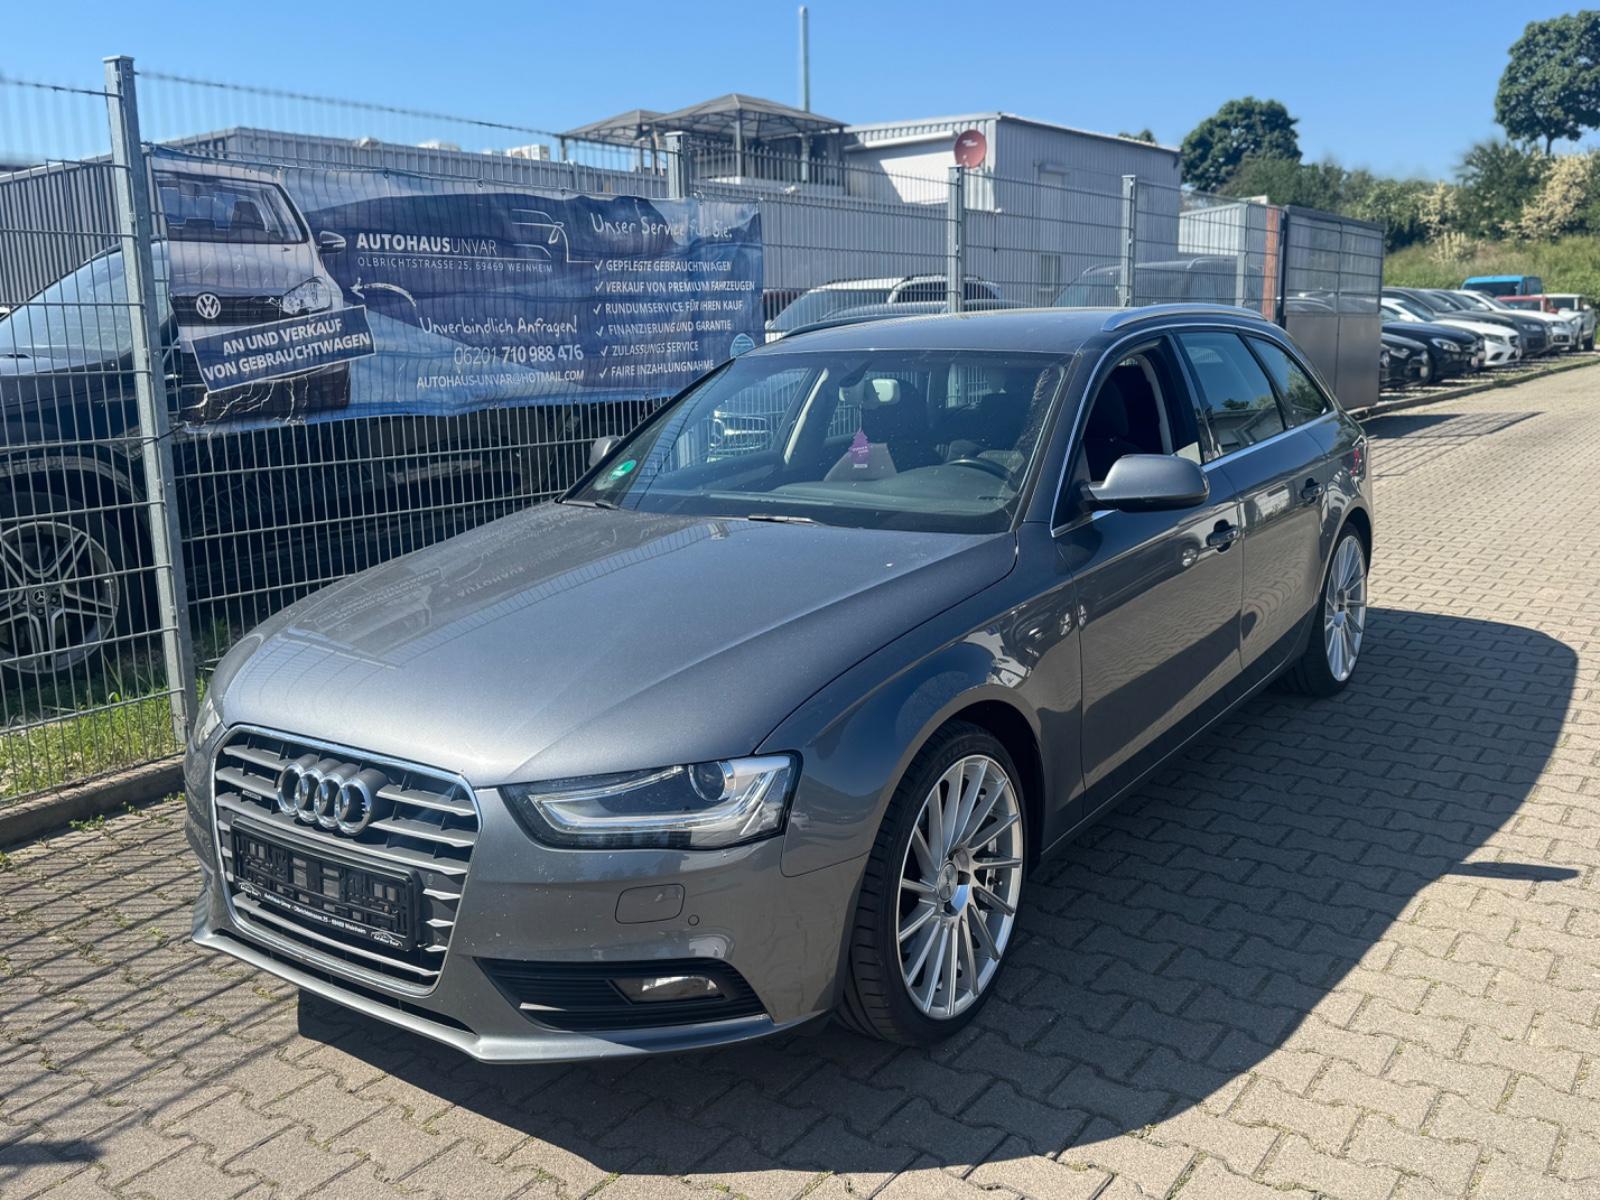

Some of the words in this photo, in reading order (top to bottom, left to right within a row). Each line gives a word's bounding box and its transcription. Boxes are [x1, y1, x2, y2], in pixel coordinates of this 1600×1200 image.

[590, 212, 637, 235] Unser
[641, 216, 685, 236] Service
[357, 257, 454, 270] OLBRICHTSTRASSE
[475, 262, 504, 272] 69469
[507, 262, 553, 273] WEINHEIM
[606, 260, 652, 272] GEPFLEGTE
[653, 260, 732, 272] GEBRAUCHTWAGEN
[606, 281, 645, 293] VERKAUF
[647, 281, 667, 293] VON
[668, 281, 709, 293] PREMIUM
[710, 280, 755, 292] FAHRZEUGEN
[605, 301, 684, 315] RUNDUMSERVICE
[723, 299, 744, 311] KAUF
[419, 317, 513, 335] Unverbindlich
[517, 314, 578, 338] Anfragen!
[608, 321, 676, 336] FINANZIERUNG
[695, 319, 732, 331] GARANTIE
[223, 338, 245, 356] AN
[246, 330, 279, 350] UND
[280, 318, 343, 343] VERKAUF
[203, 363, 238, 382] VON
[238, 332, 371, 373] GEBRAUCHTWAGEN
[454, 346, 497, 366] 06201
[501, 346, 526, 364] 710
[529, 345, 556, 363] 988
[557, 344, 584, 361] 476
[612, 343, 665, 357] ZULASSUNGS
[666, 340, 699, 354] SERVICE
[611, 364, 636, 378] FAIRE
[636, 359, 715, 375] INZAHLUNGNAHME
[416, 369, 585, 389] AUTOHAUS-UNVAR@HOTMAIL.COM
